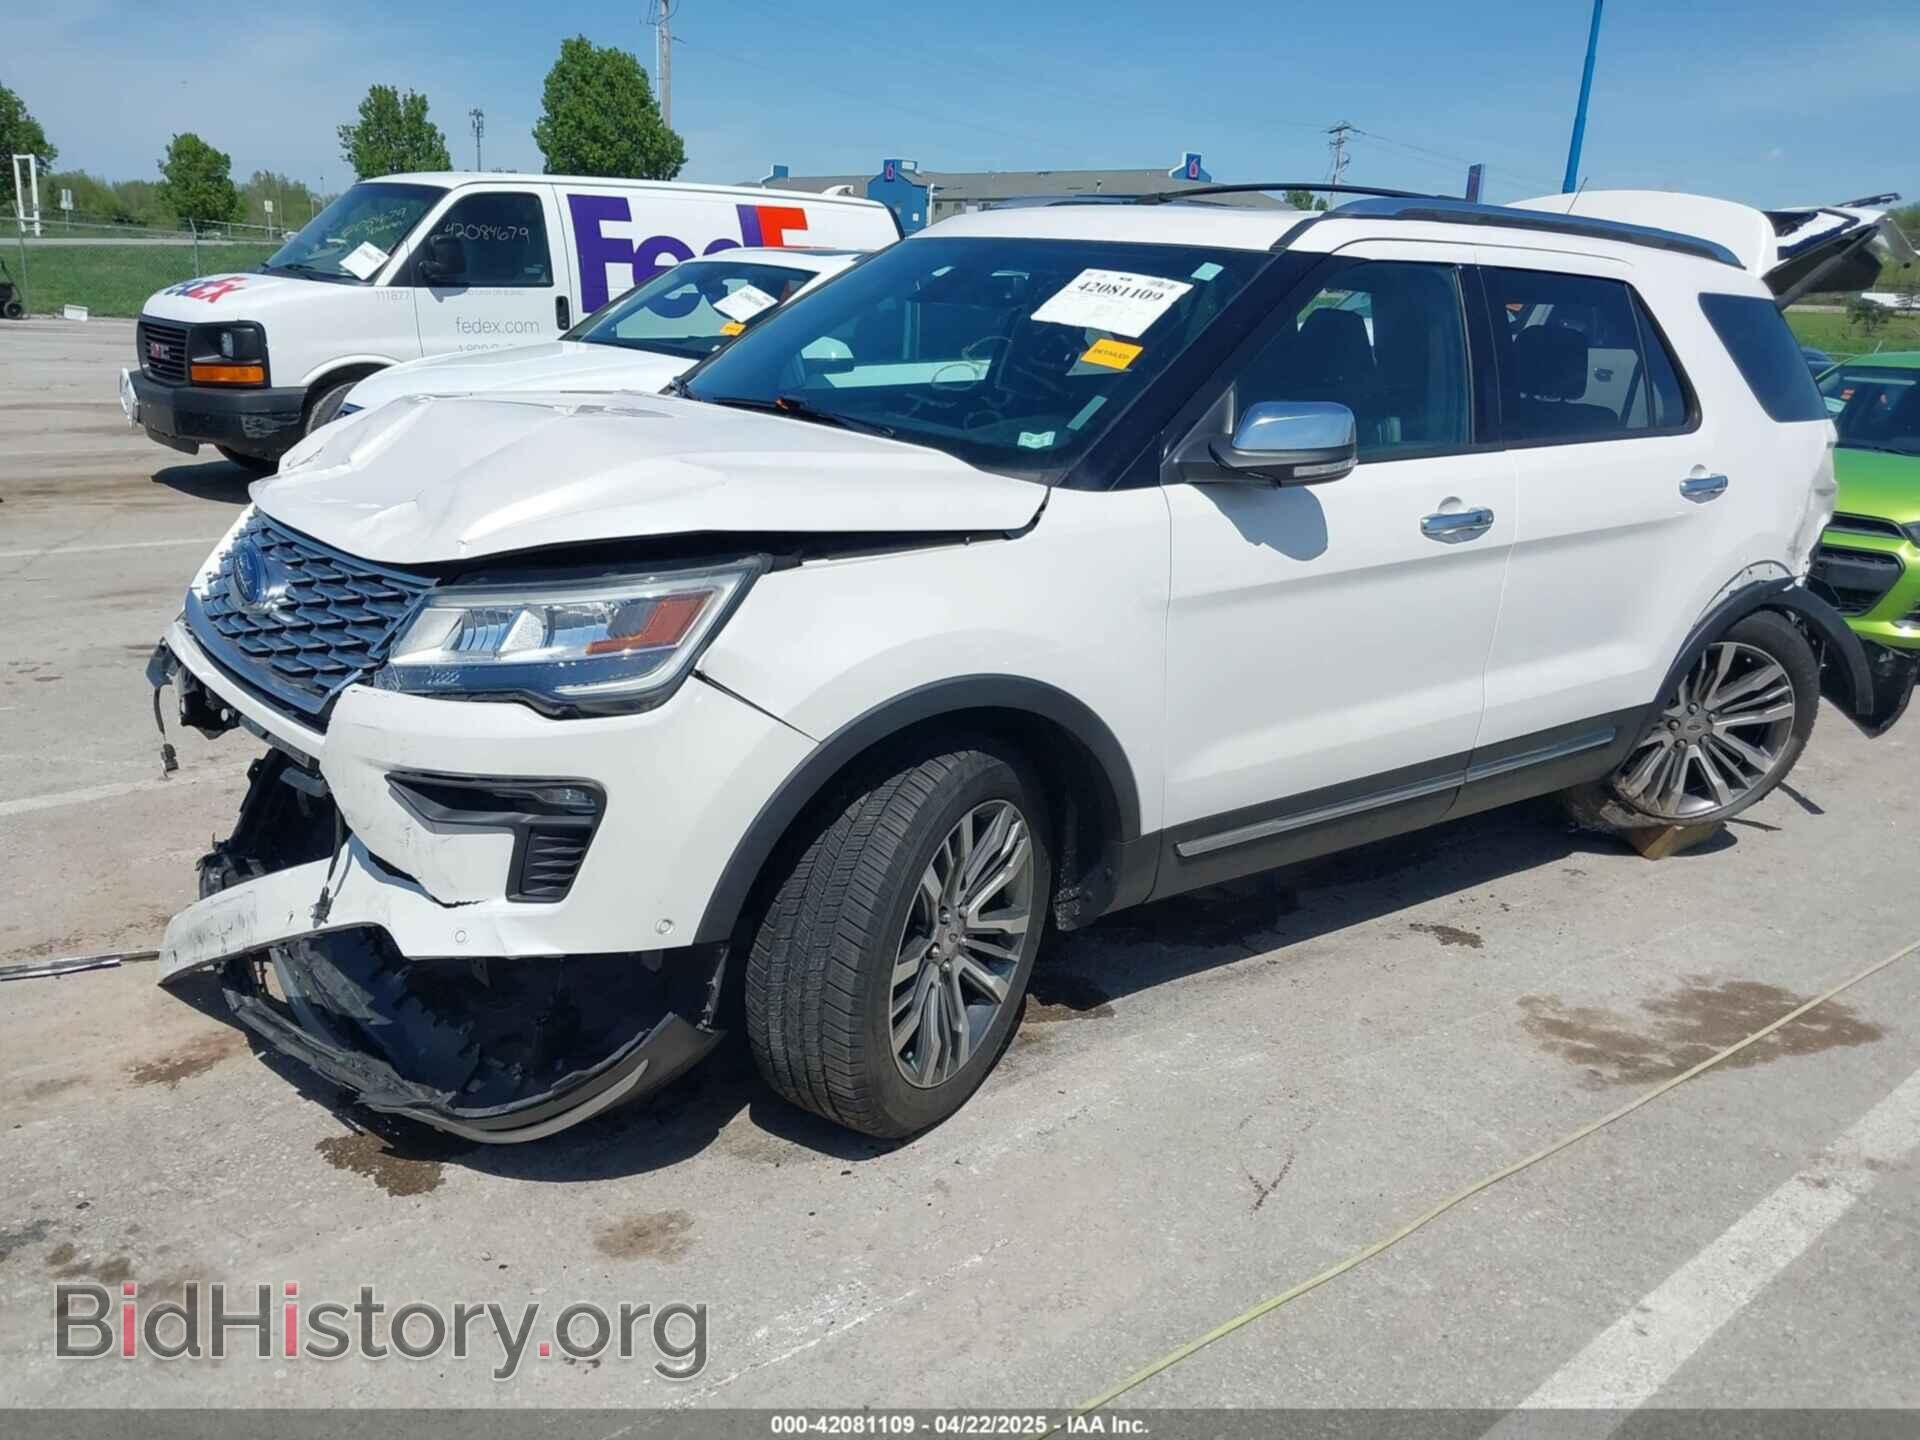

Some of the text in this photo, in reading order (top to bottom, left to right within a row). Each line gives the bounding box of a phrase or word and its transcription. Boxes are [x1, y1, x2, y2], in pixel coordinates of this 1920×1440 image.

[1189, 158, 1199, 177] 6
[444, 223, 530, 245] 42084679
[1078, 280, 1165, 302] 42081109
[456, 316, 540, 334] fedex.com
